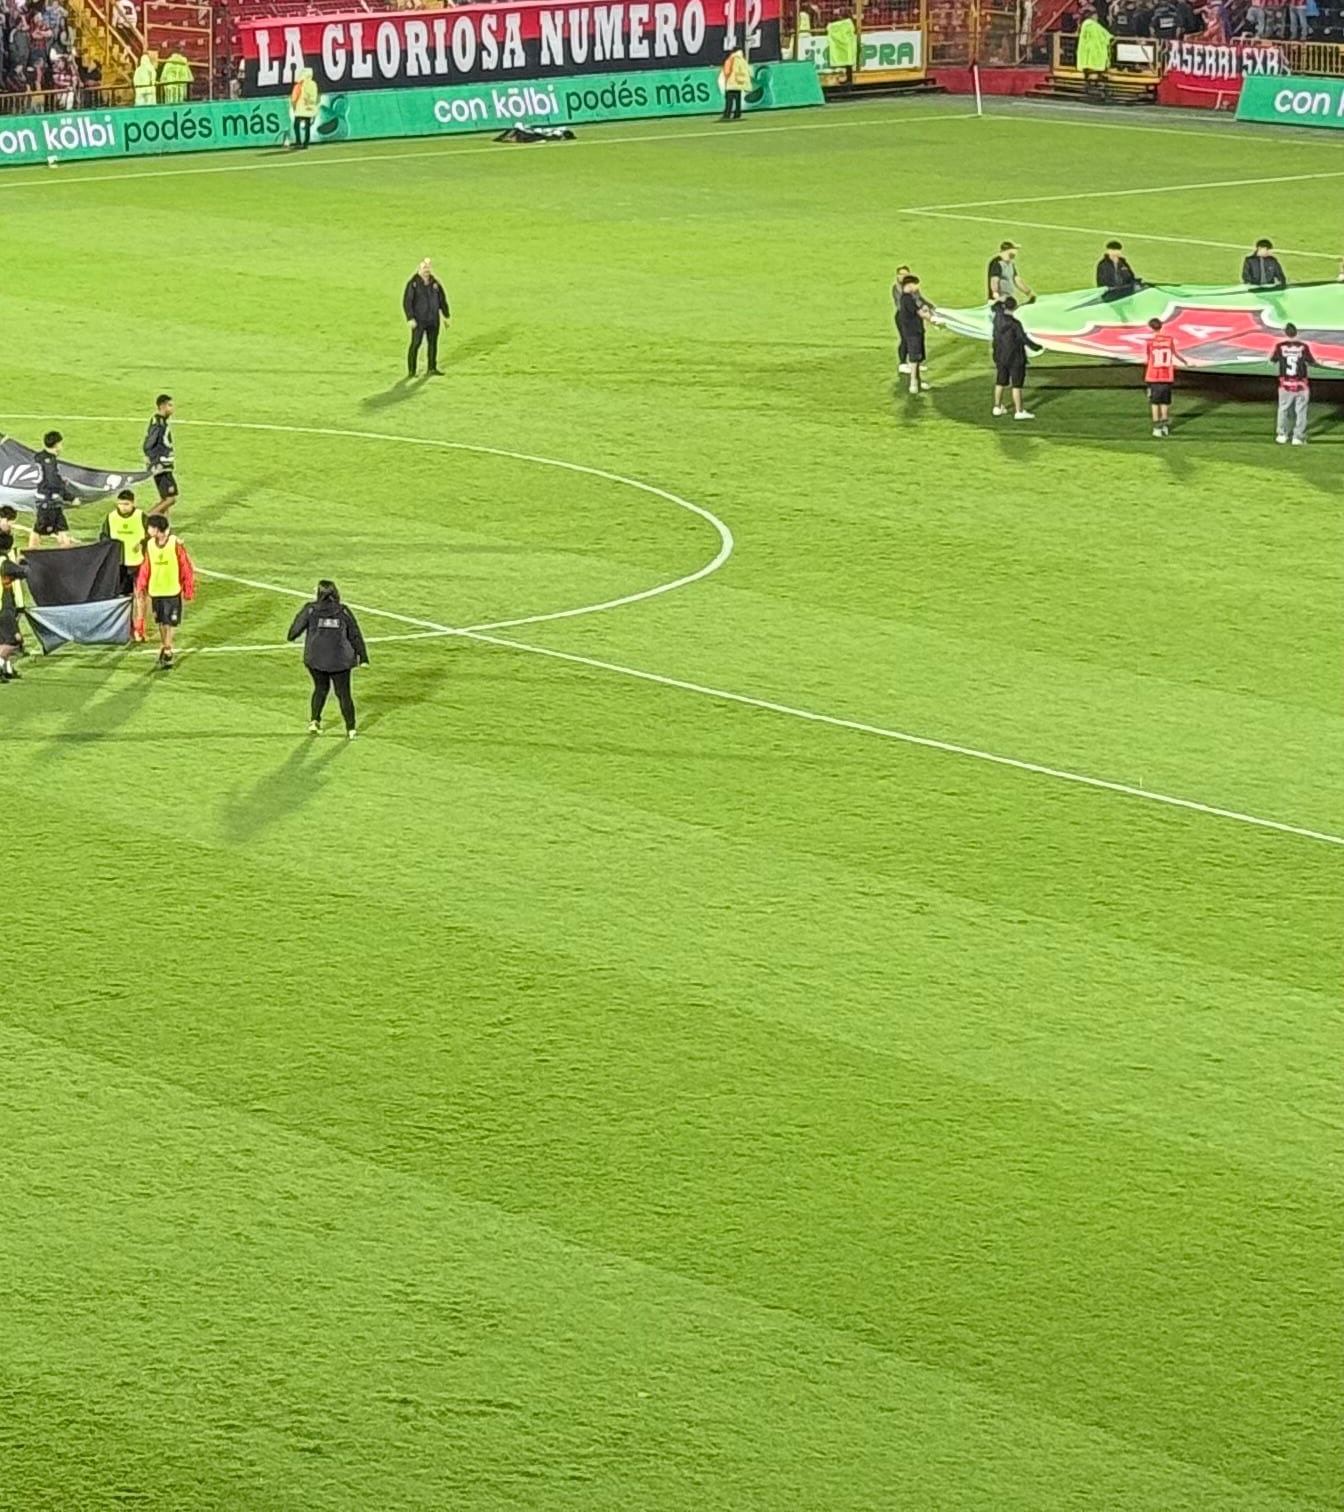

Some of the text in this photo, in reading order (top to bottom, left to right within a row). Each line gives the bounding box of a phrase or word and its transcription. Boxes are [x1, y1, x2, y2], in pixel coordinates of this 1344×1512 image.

[255, 26, 305, 87] LA
[321, 11, 523, 82] GLORIOSA
[434, 77, 711, 125] con kölbi podés más
[1274, 89, 1331, 117] con
[44, 112, 115, 151] kölbi
[124, 113, 213, 154] podés
[222, 108, 280, 135] más
[1152, 349, 1172, 368] 10
